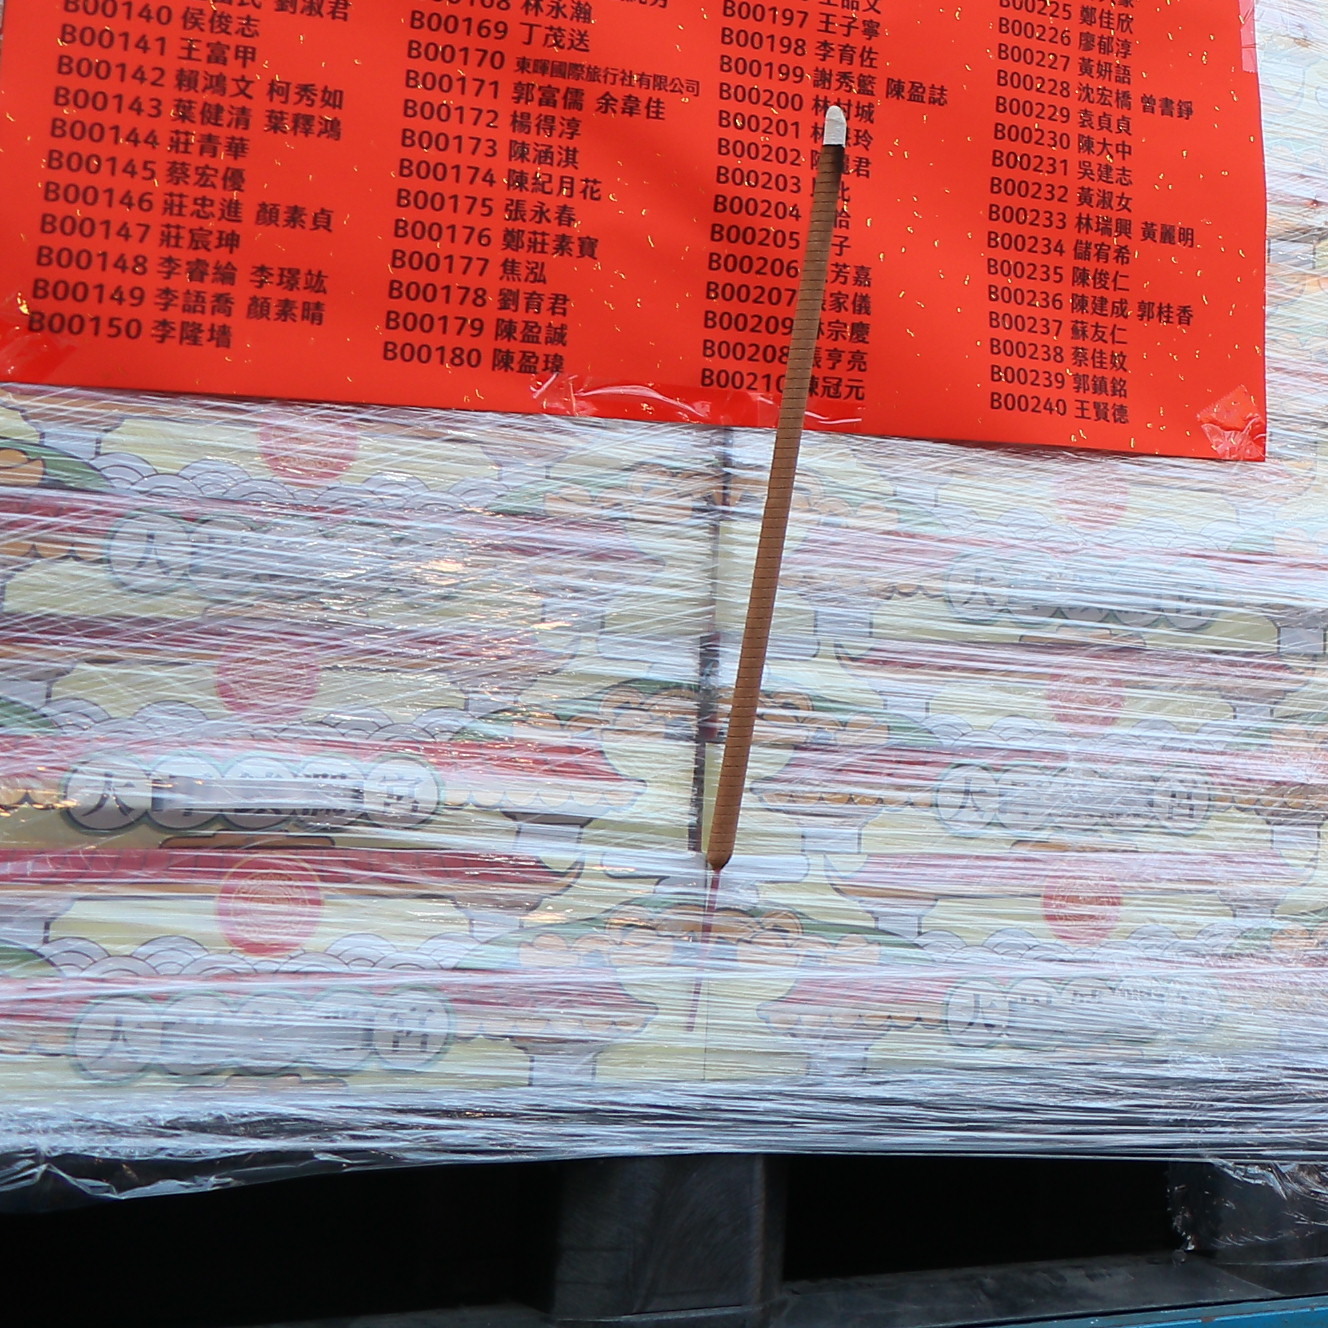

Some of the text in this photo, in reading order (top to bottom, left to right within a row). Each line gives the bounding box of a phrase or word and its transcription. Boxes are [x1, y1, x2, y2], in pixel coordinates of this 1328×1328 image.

[410, 9, 590, 53] B00169 丁茂送
[722, 0, 881, 41] B00197 王子寧
[407, 39, 505, 70] B00170
[57, 54, 344, 110] B00142 賴鴻文 柯秀如
[994, 122, 1132, 160] B00230 陳大中
[399, 158, 602, 202] B00174 陳紀月花
[992, 149, 1133, 187] B00231 吳建志
[390, 249, 547, 284] B00177 焦泓
[32, 278, 146, 307] B00149
[388, 279, 571, 317] B00178 劉育君
[988, 284, 1194, 326] B00236 陳建成 郭桂香
[990, 391, 1129, 424] B00240 王賢德
